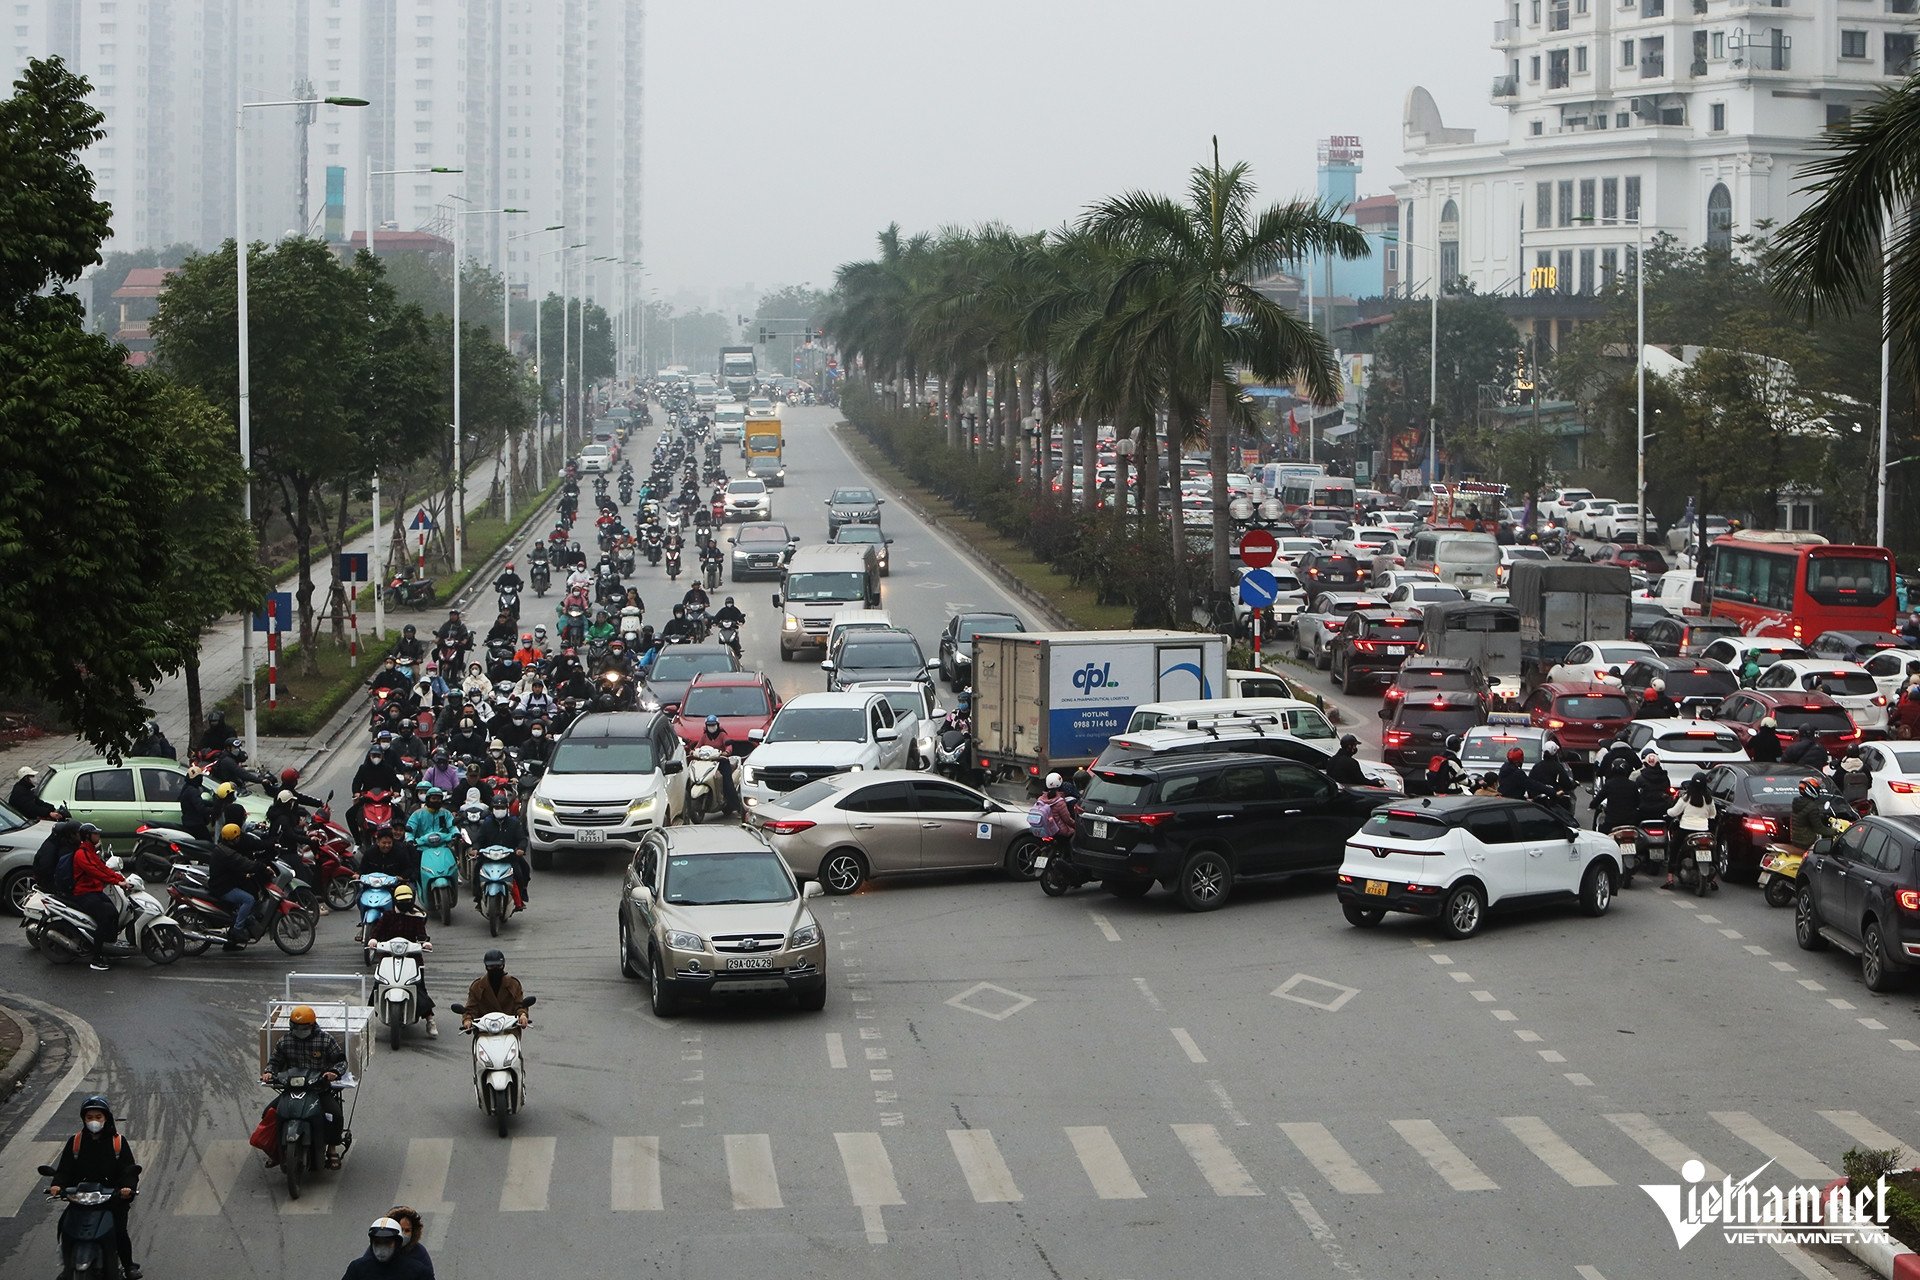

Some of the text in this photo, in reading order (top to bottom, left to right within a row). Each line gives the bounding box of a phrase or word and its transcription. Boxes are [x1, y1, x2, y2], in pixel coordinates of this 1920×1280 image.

[1331, 135, 1361, 147] HOTEL
[1530, 266, 1556, 289] CT1B
[1073, 719, 1118, 729] 0988 714 068
